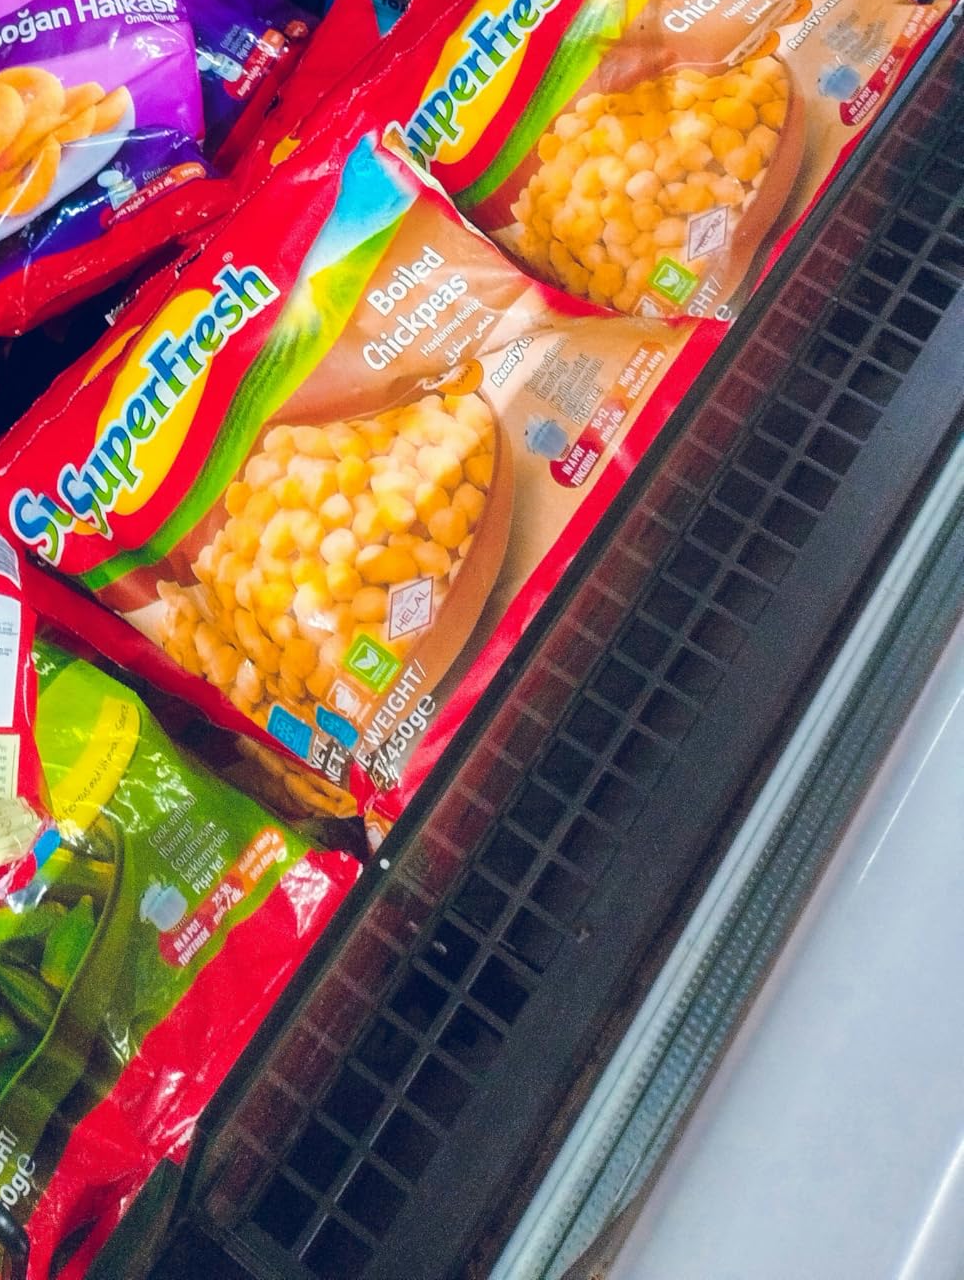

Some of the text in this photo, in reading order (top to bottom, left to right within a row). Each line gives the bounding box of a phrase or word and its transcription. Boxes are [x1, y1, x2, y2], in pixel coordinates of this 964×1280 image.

[786, 17, 821, 51] Ready
[366, 245, 446, 318] Boiled
[687, 276, 724, 319] GHT/
[362, 273, 469, 371] Chickpeas
[456, 298, 484, 325] Nohut
[489, 346, 525, 389] Ready
[619, 366, 636, 388] High
[56, 261, 280, 537] SuperFresh
[590, 408, 608, 431] 10-12
[395, 589, 430, 633] HELAL
[364, 657, 427, 746] WEIGHT/
[192, 871, 214, 895] Pişir
